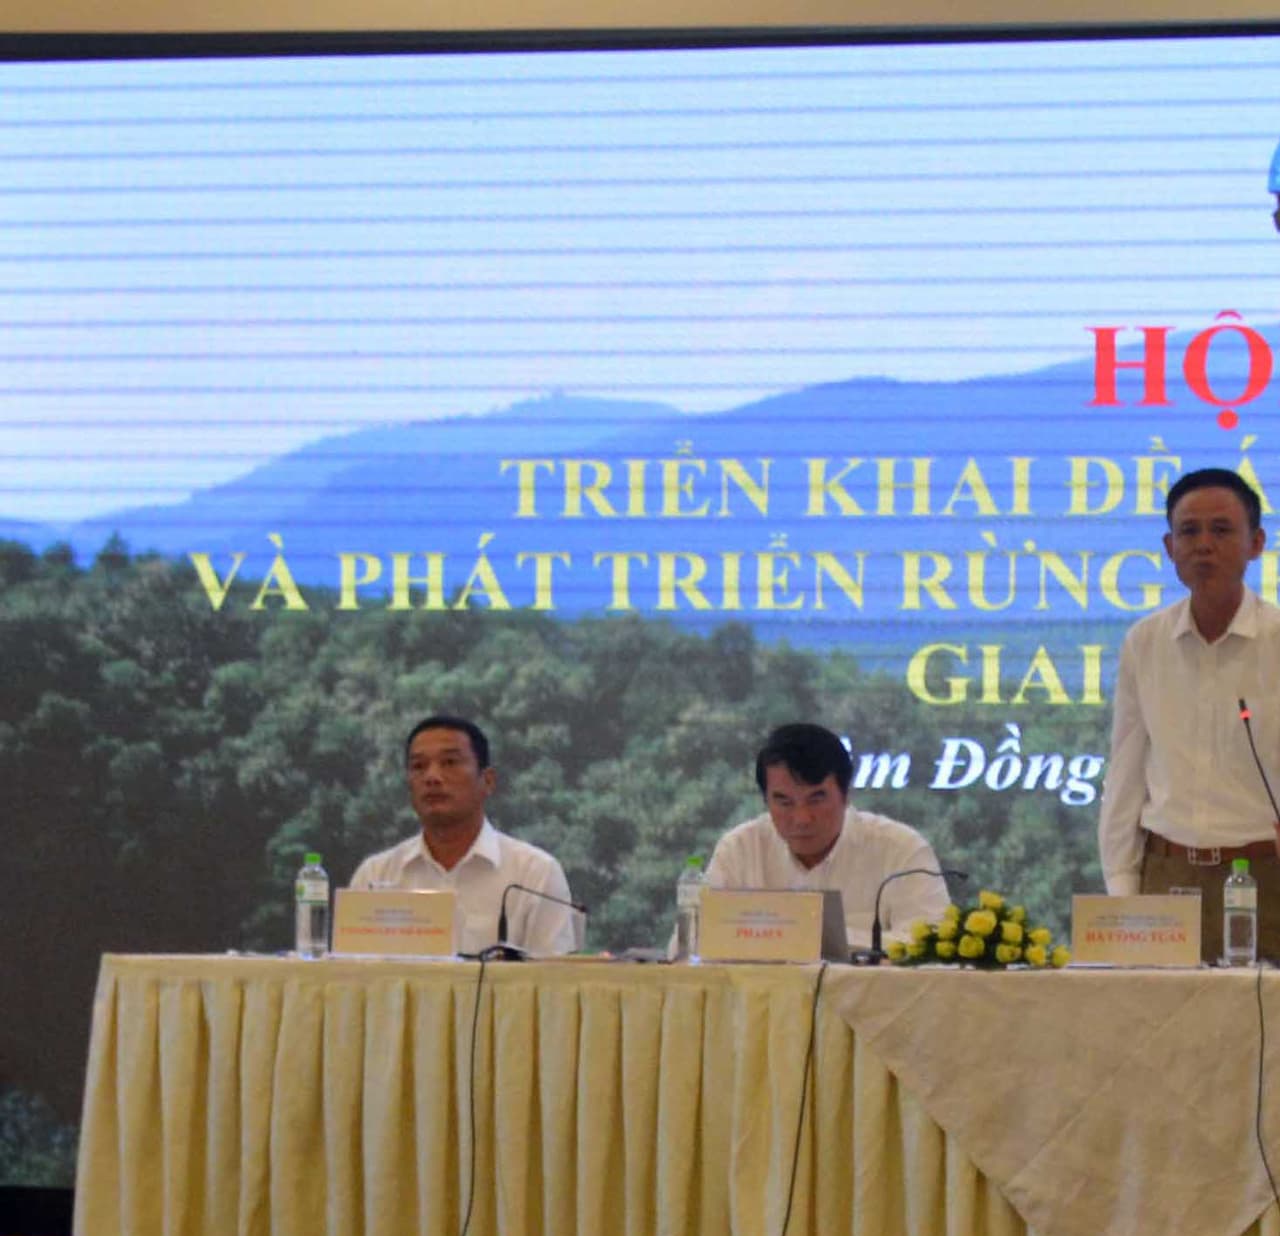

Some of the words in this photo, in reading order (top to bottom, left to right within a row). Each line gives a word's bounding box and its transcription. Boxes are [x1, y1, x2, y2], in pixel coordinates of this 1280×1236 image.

[500, 440, 772, 518] TRIỂN
[804, 456, 1037, 517] KHAI
[187, 531, 310, 611] VÀ
[335, 531, 572, 611] PHÁT
[592, 532, 870, 611] TRIỂN
[898, 530, 1165, 611] RỪNG
[905, 643, 1107, 706] GIAI
